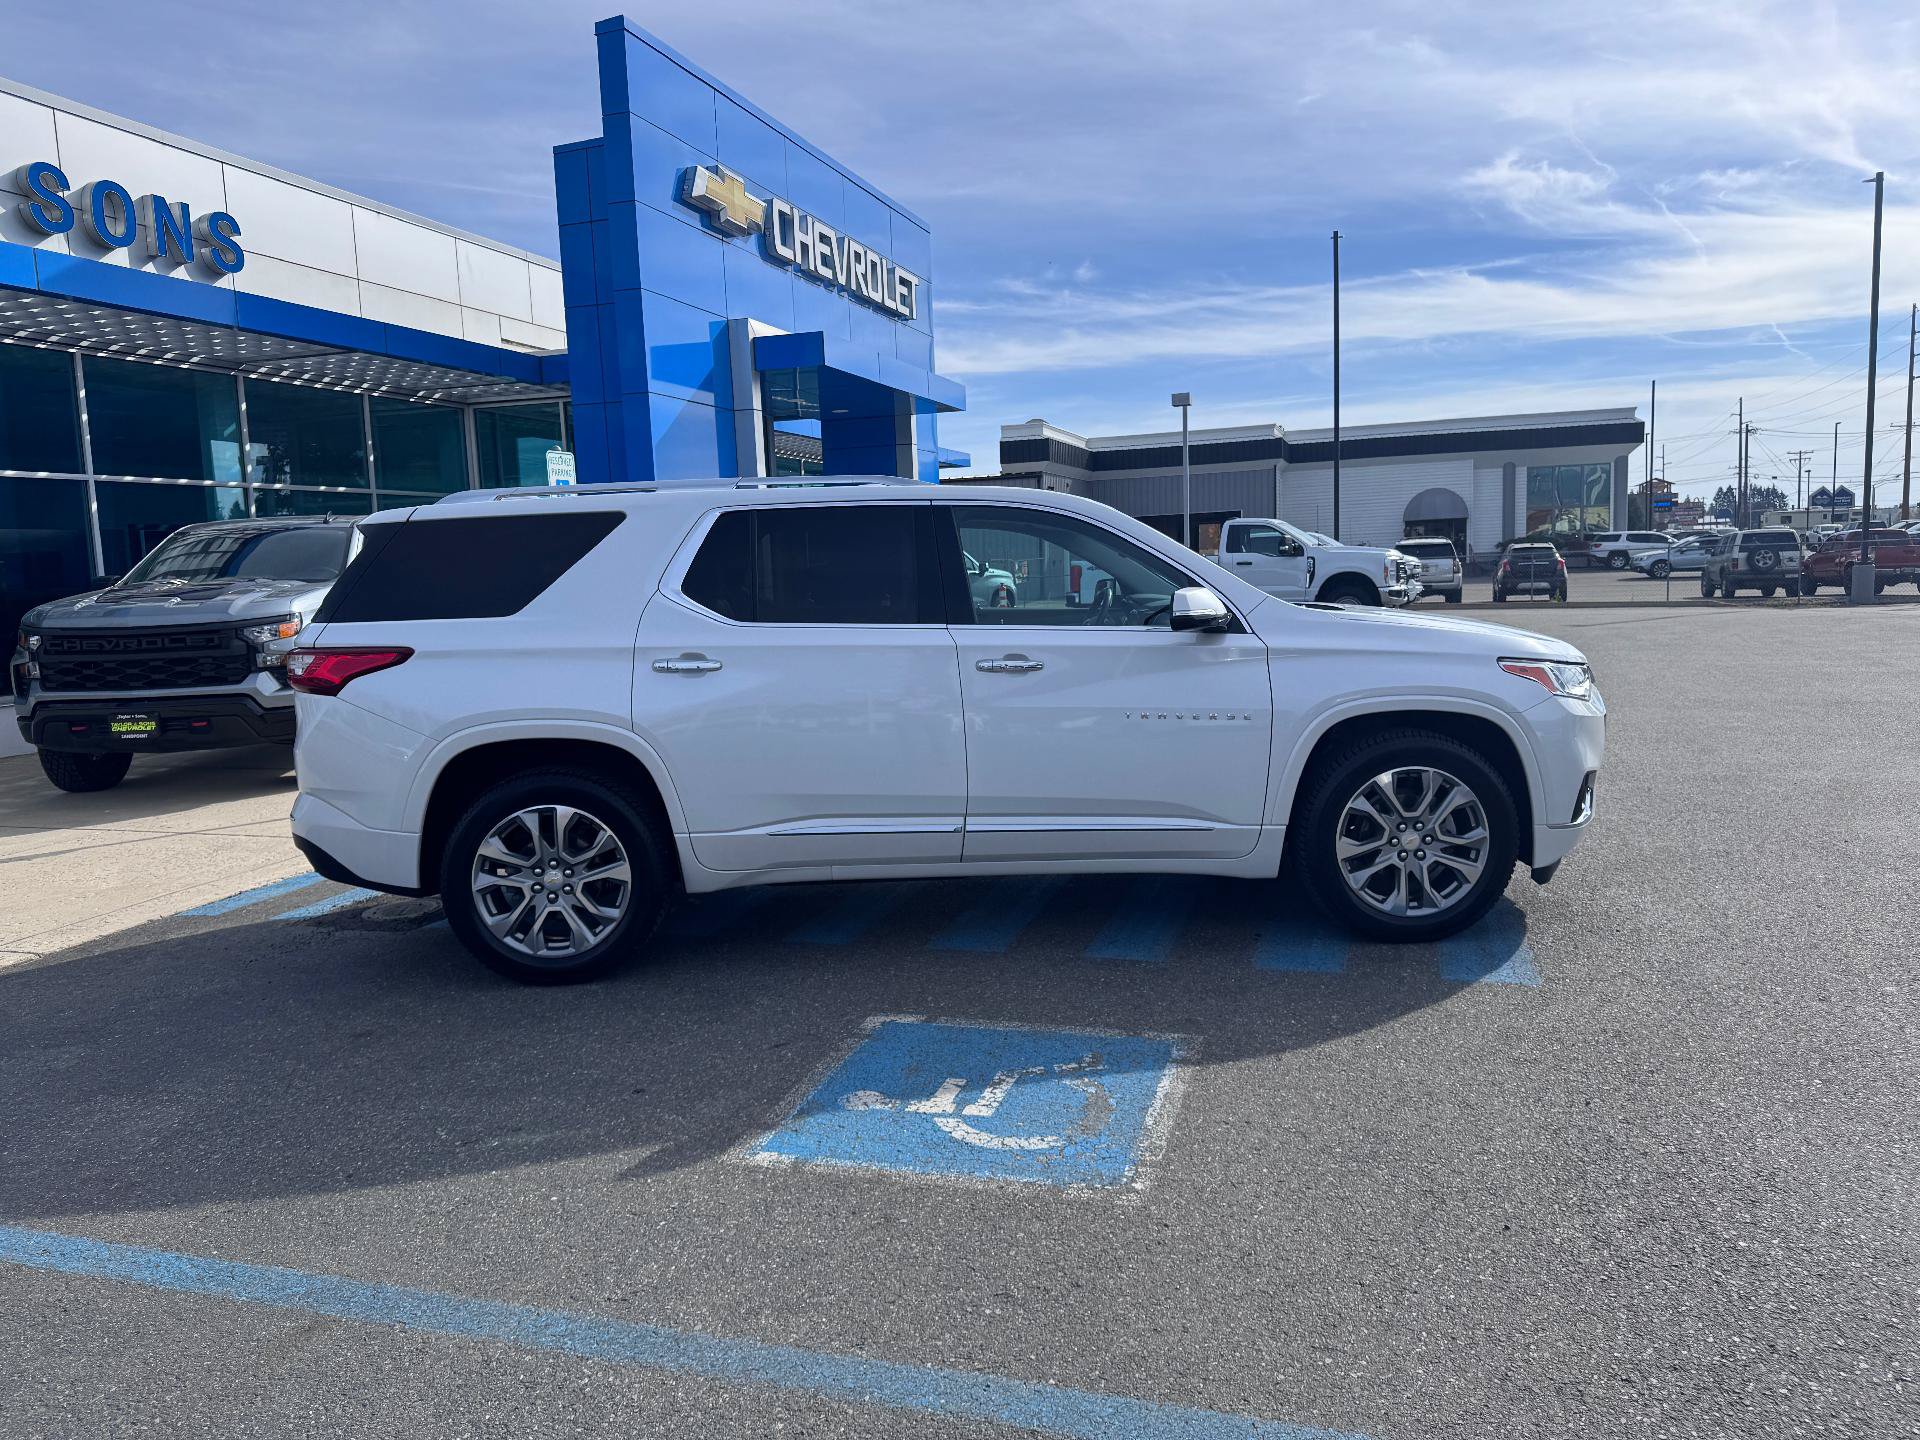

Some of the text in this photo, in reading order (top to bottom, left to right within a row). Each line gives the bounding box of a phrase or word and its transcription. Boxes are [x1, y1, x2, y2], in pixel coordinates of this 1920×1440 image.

[24, 162, 245, 274] SONS
[769, 197, 919, 321] CHEVROLET
[46, 635, 228, 651] CHEVROLET
[1123, 712, 1252, 721] TRAVERSE
